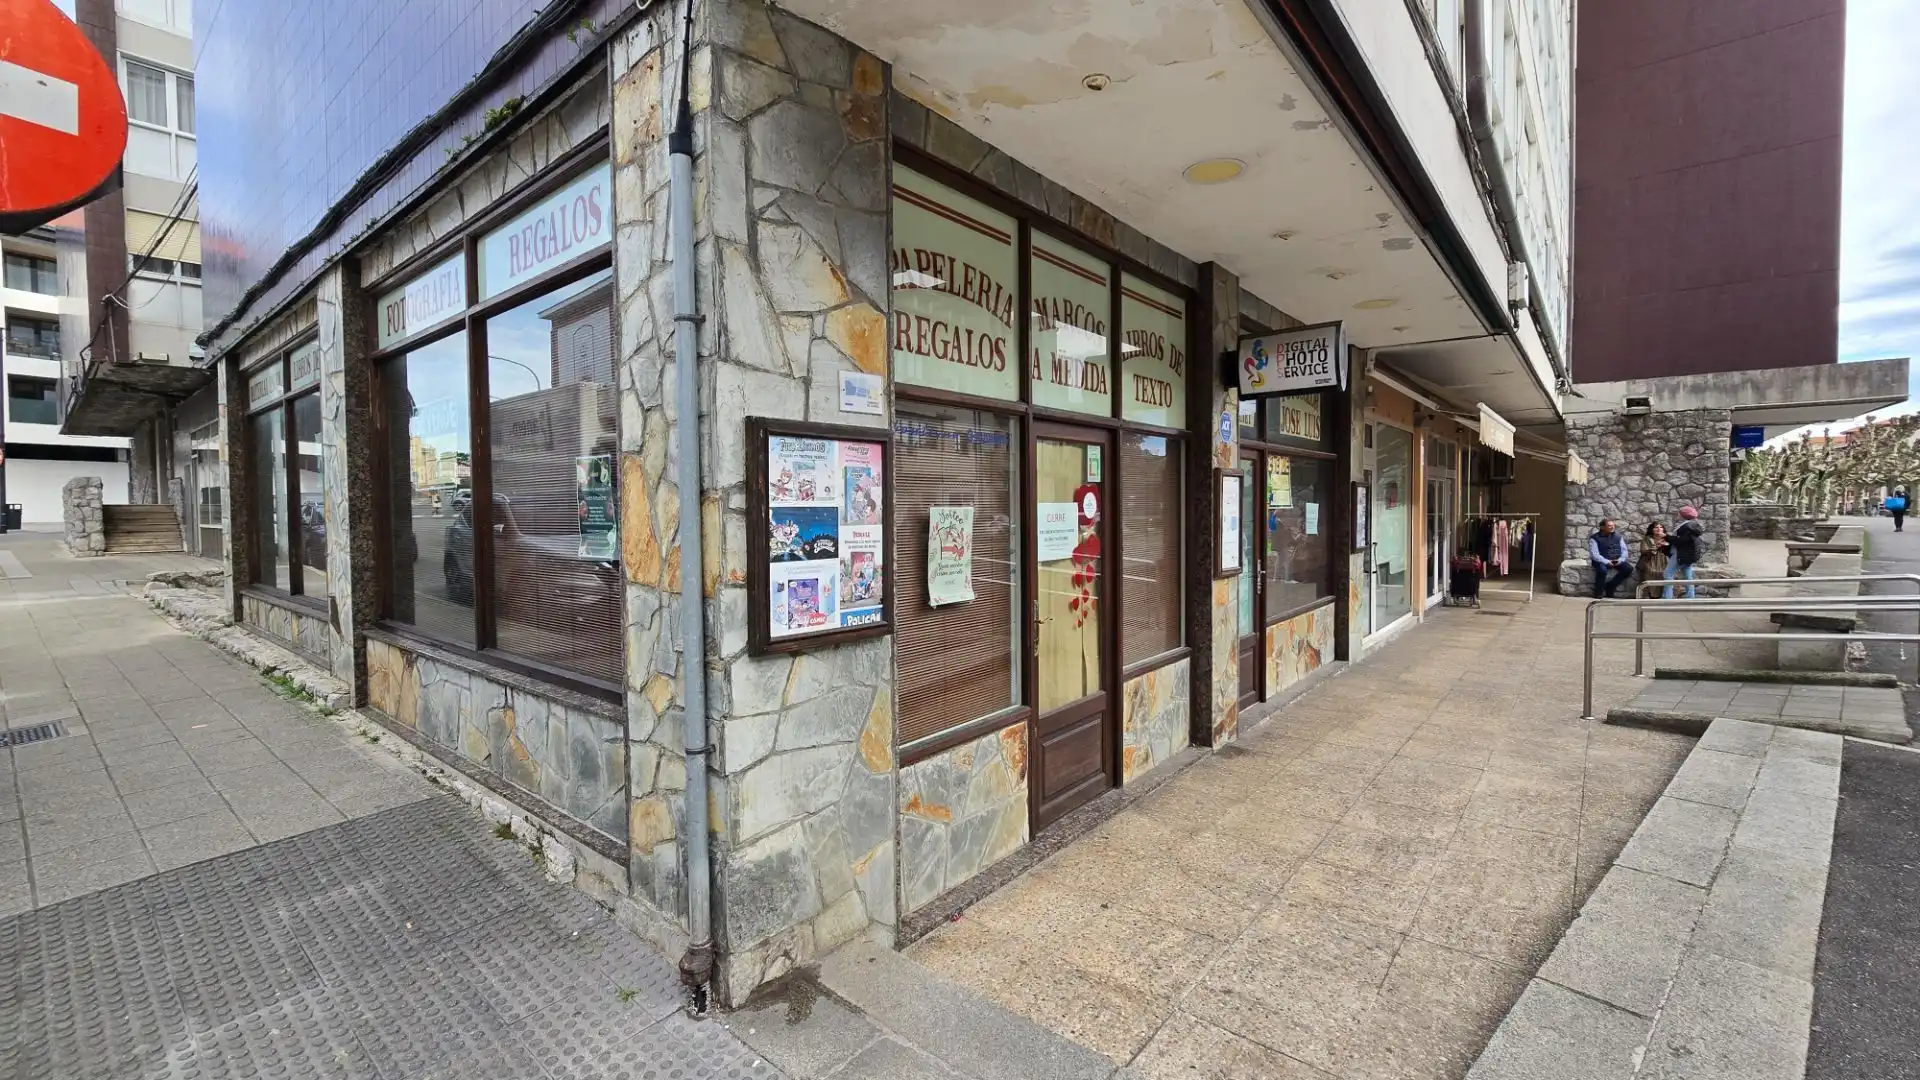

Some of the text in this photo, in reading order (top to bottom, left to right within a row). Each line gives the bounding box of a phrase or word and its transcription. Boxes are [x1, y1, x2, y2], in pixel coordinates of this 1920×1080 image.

[509, 184, 602, 278] REGALOS
[387, 267, 461, 337] FOTOGRAFIA
[1034, 297, 1106, 343] MARCOS
[894, 310, 1006, 372] REGALOS
[1276, 337, 1329, 355] DIGITAL
[1276, 348, 1328, 367] PHOTO
[1032, 348, 1108, 395] A MEDIDA
[1169, 343, 1184, 378] DE
[1276, 362, 1329, 378] SERVICE
[1133, 373, 1173, 408] TEXTO
[1281, 405, 1301, 435] JOSE
[1304, 411, 1321, 440] LUIS
